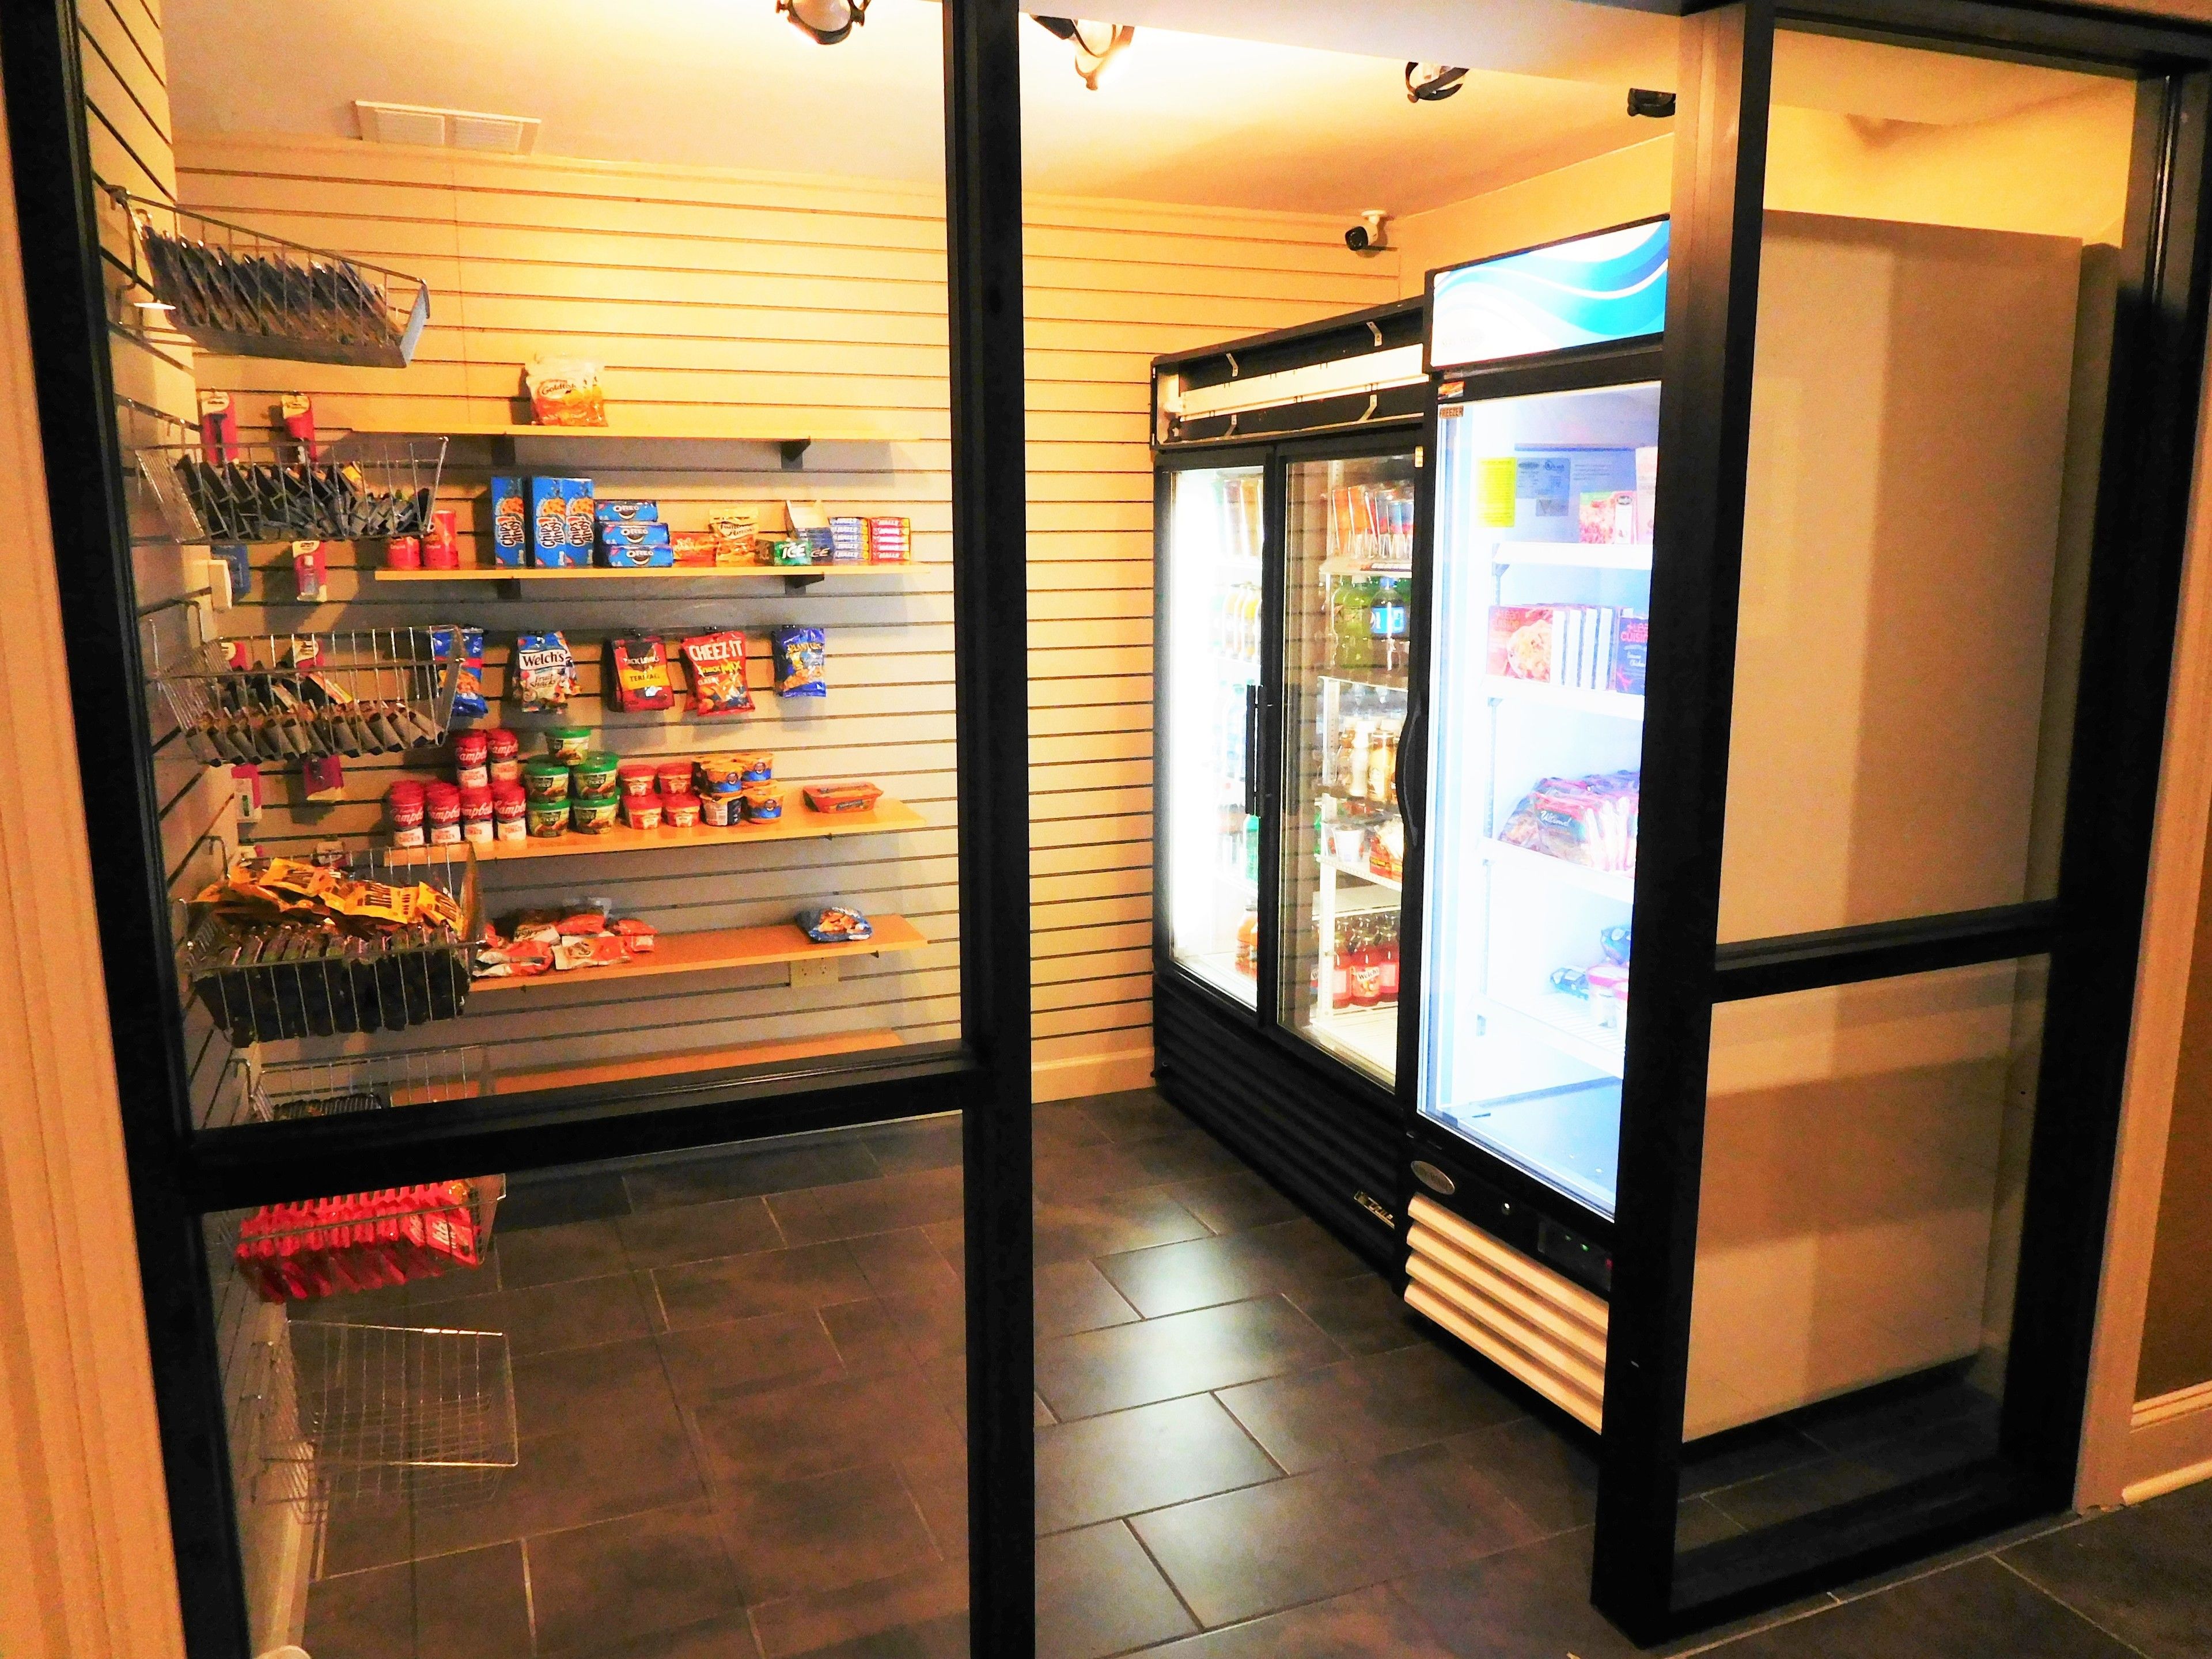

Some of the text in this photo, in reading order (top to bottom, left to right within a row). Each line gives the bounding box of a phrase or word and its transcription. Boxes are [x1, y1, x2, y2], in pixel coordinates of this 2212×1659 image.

[500, 522, 514, 546] Chips
[540, 523, 555, 547] Chips
[570, 522, 584, 546] Chips
[782, 543, 806, 559] ICE
[522, 652, 565, 667] Welch's
